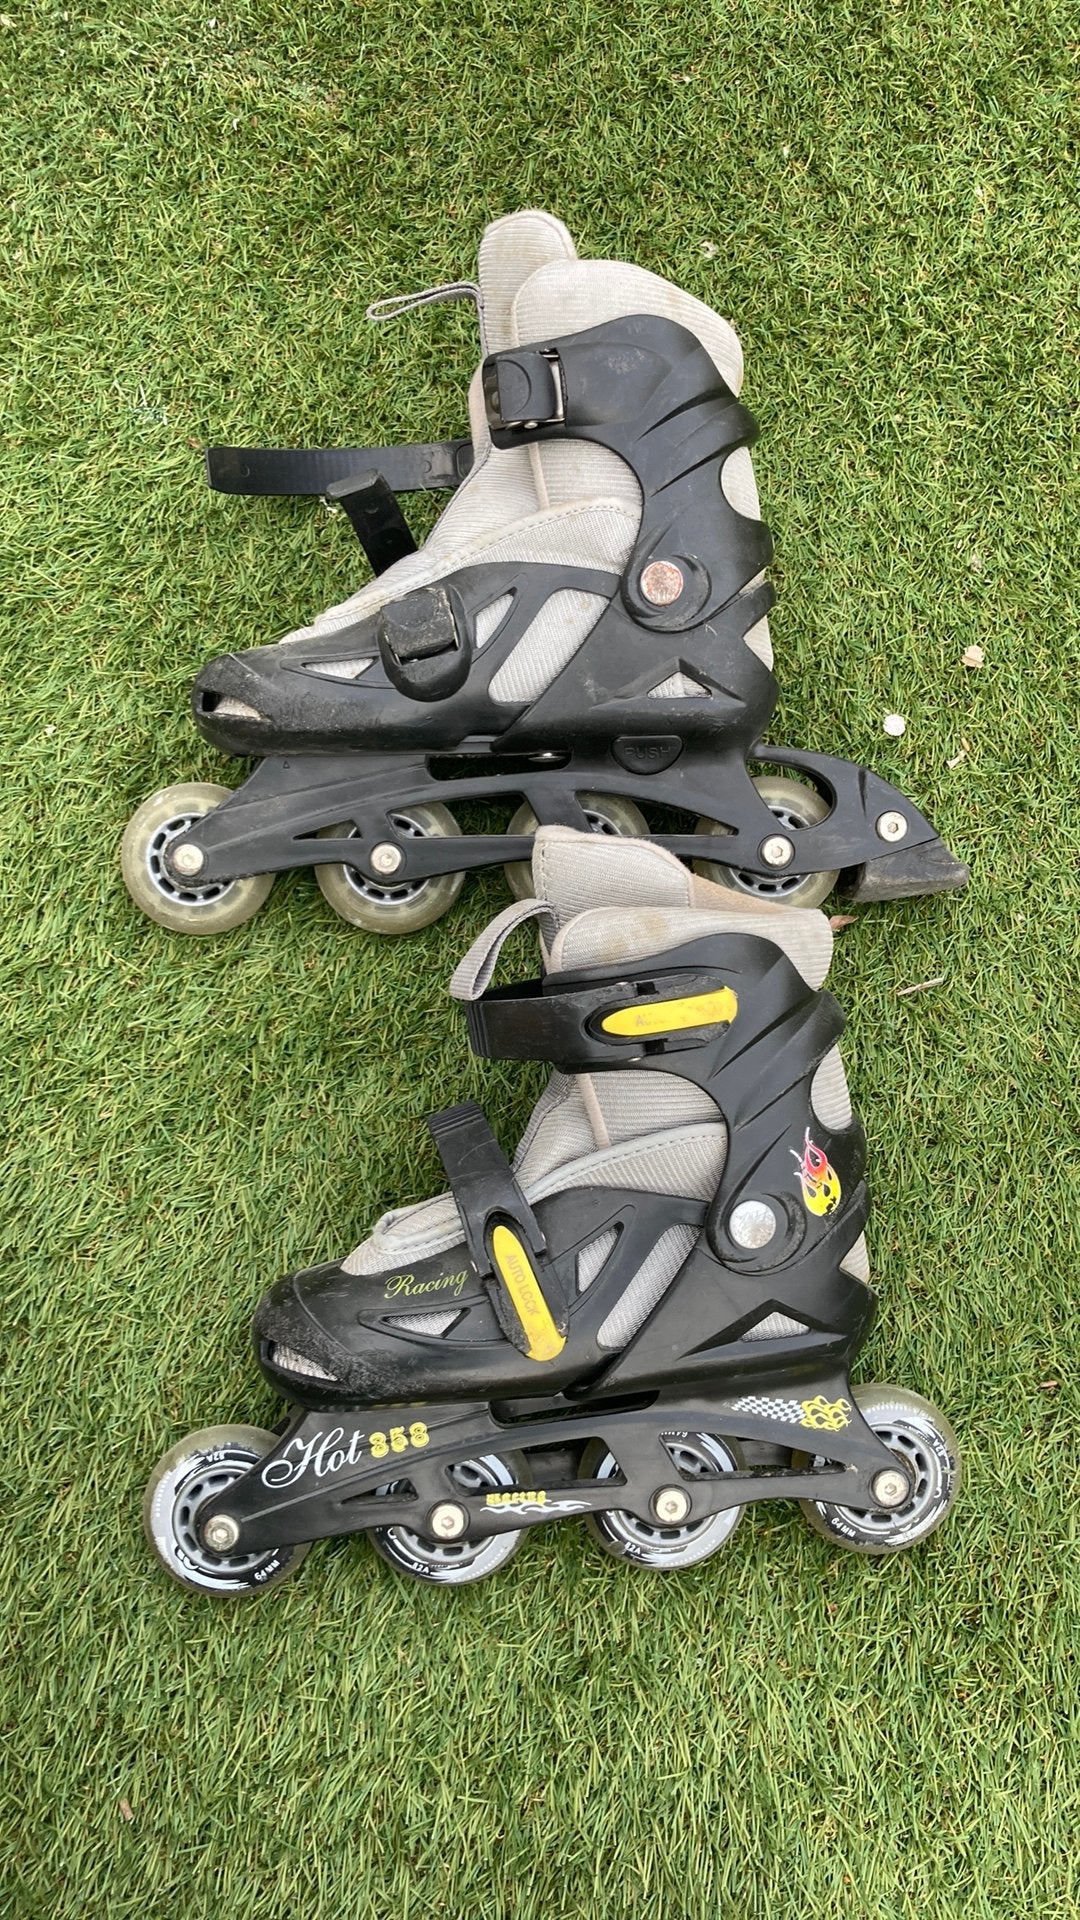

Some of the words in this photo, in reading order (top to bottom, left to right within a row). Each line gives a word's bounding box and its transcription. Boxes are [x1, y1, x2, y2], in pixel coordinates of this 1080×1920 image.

[624, 745, 671, 760] PUSH
[505, 1254, 526, 1288] AUTO
[384, 1269, 468, 1299] Racing
[206, 1451, 226, 1464] 82A
[261, 1426, 364, 1489] Hot
[831, 1518, 856, 1538] 64MM
[624, 1541, 642, 1555] 82A
[254, 1559, 280, 1581] 64MM
[412, 1561, 431, 1575] 82A
